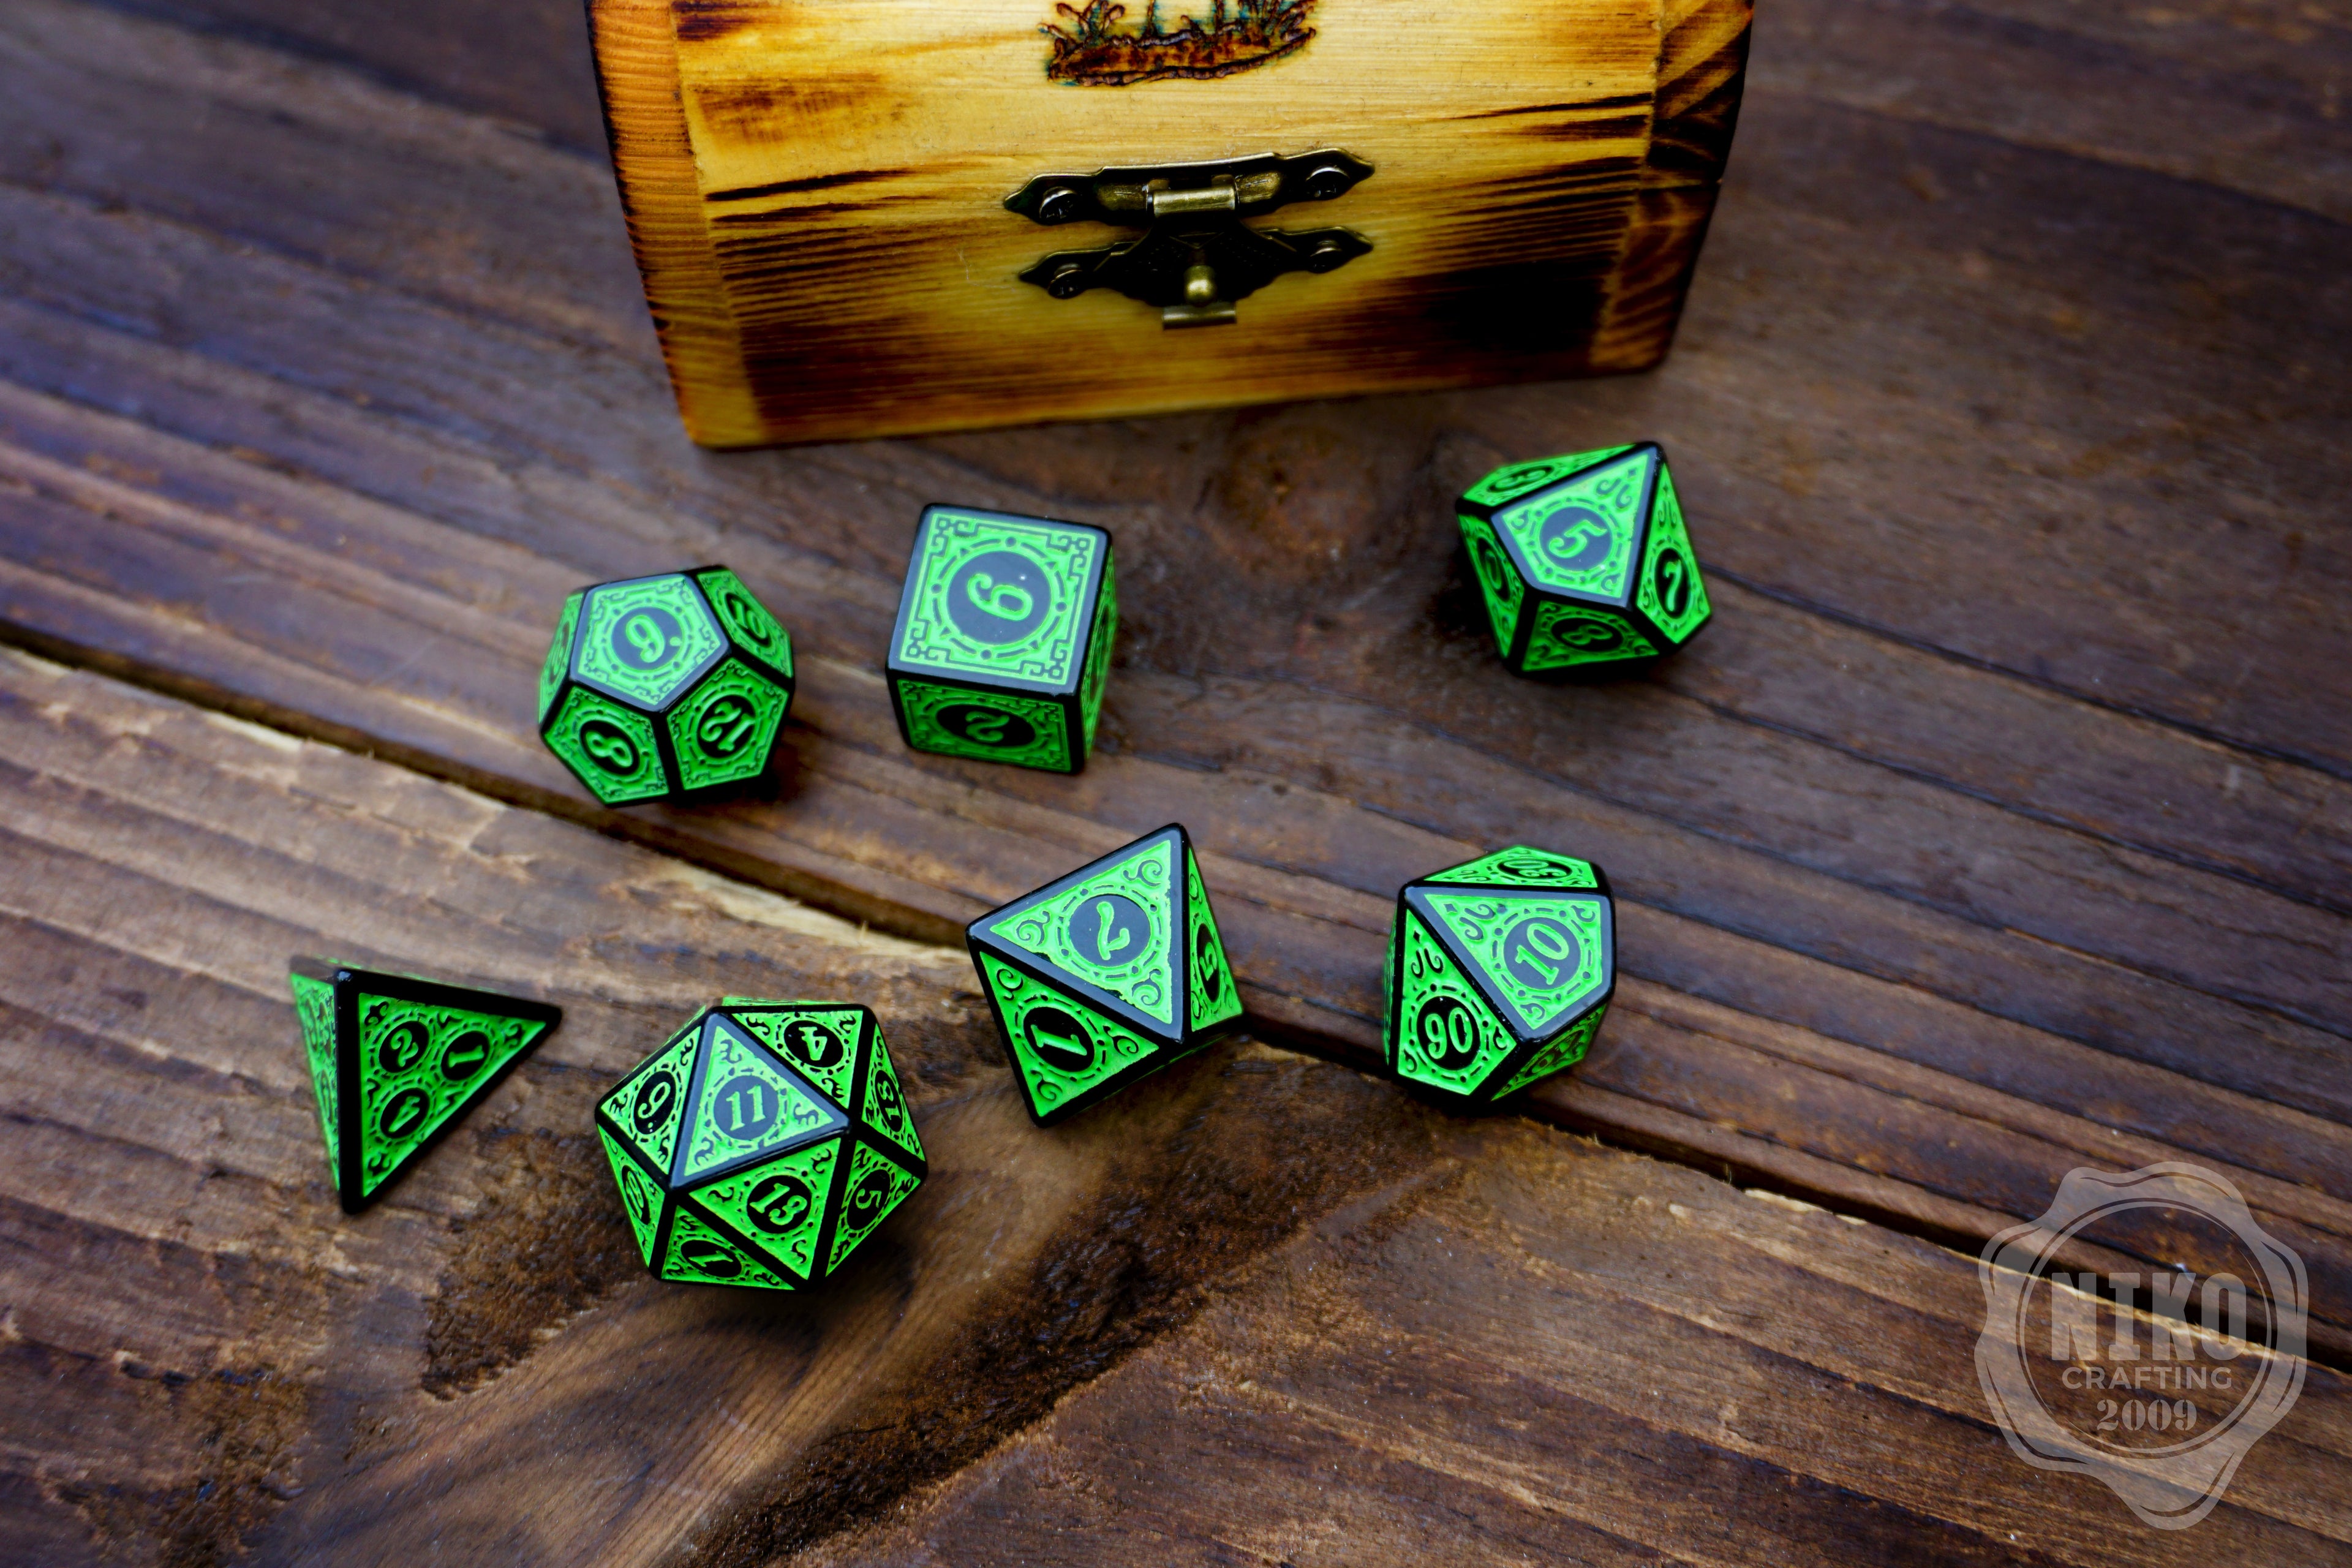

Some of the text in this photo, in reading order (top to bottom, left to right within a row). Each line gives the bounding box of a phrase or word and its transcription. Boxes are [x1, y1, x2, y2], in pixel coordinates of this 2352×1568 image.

[1548, 519, 1608, 558] 5
[966, 573, 1033, 622] 6
[1663, 559, 1683, 612] 7
[731, 599, 767, 639] 10
[1561, 625, 1613, 646] 8
[700, 701, 755, 752] 12
[965, 711, 1010, 743] 2
[584, 729, 634, 768] 8
[1504, 860, 1567, 877] 30
[1096, 901, 1131, 961] 7
[1515, 923, 1570, 986] 10
[390, 1028, 420, 1068] 2
[798, 1026, 828, 1061] 4
[1030, 1023, 1088, 1057] 1
[1424, 1006, 1474, 1060] 90
[447, 1044, 485, 1068] 1
[726, 1085, 766, 1131] 11
[750, 1183, 809, 1226] 13
[855, 1188, 882, 1210] 5
[688, 1250, 734, 1267] 1
